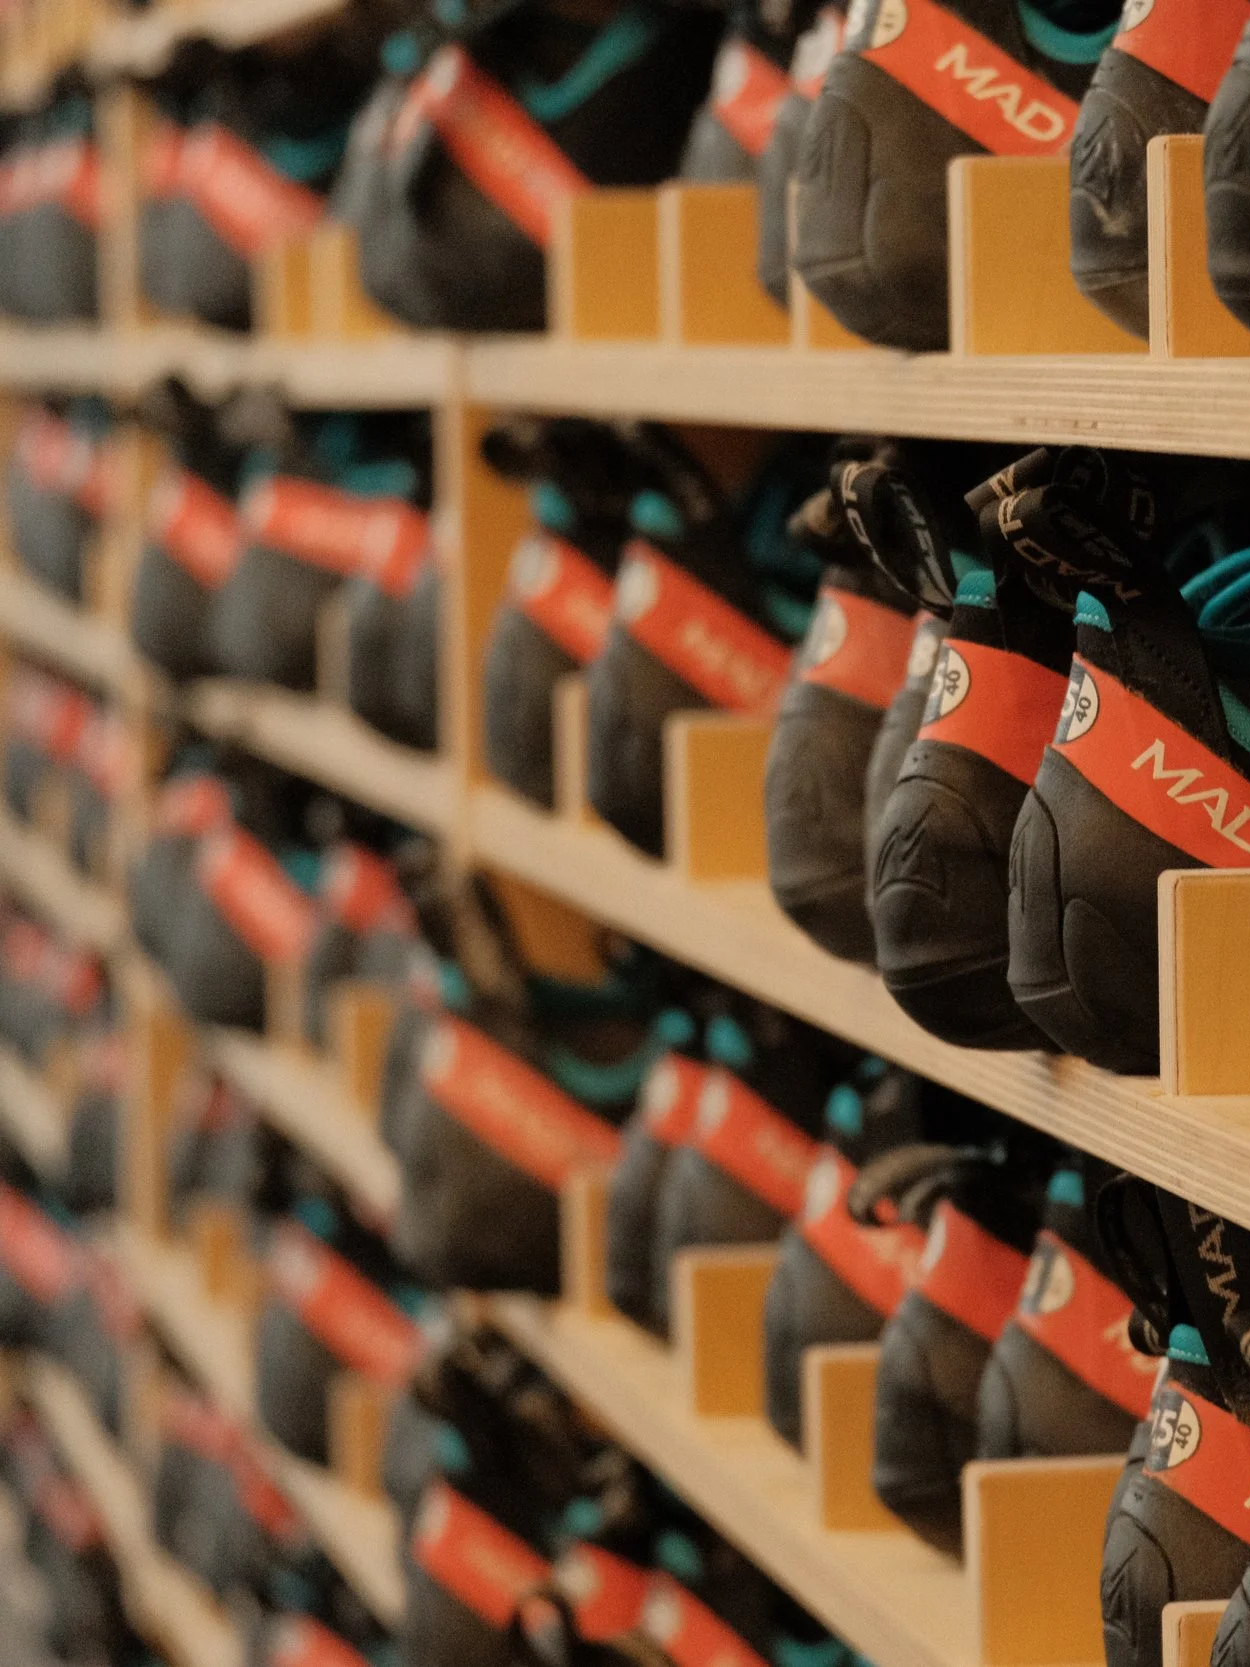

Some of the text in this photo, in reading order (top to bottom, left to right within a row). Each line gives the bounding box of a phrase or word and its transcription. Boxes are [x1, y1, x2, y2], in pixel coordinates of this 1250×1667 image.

[934, 43, 1065, 142] MAD
[944, 670, 962, 696] 40
[1074, 696, 1092, 723] 40
[1174, 1423, 1193, 1449] 40
